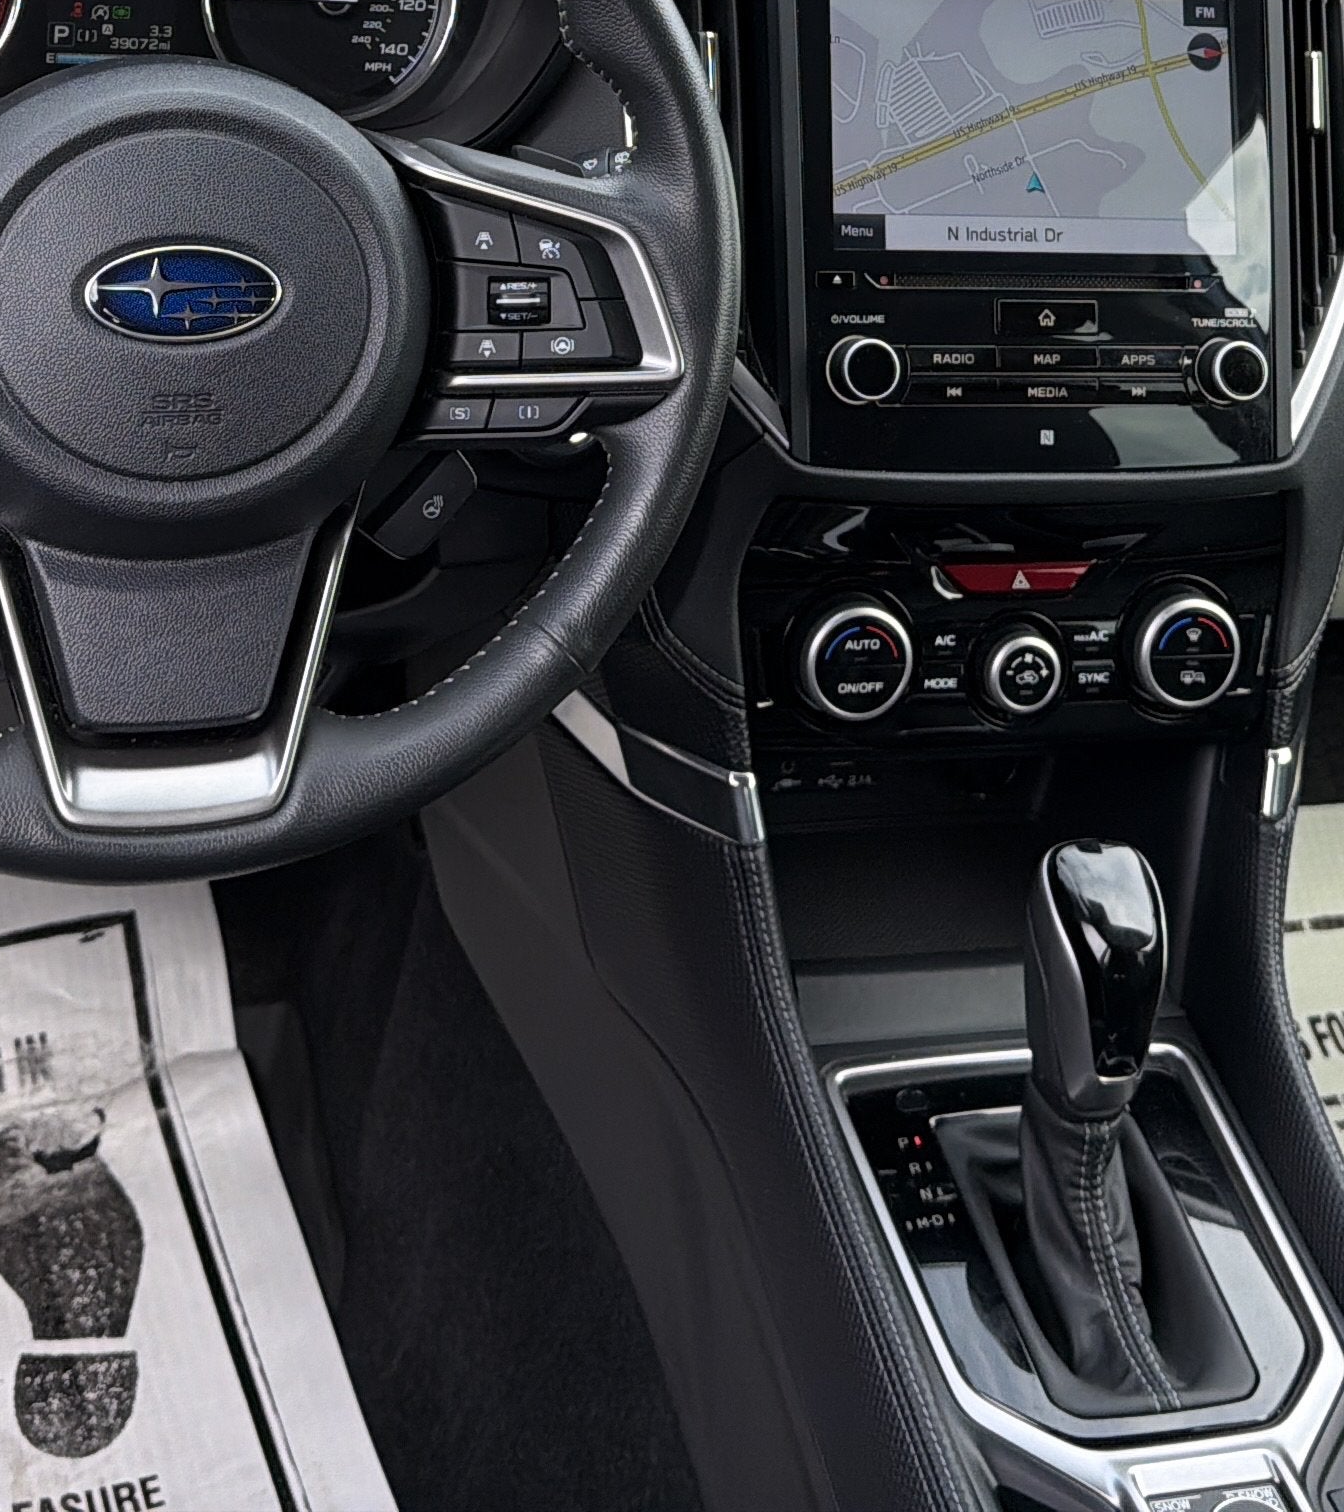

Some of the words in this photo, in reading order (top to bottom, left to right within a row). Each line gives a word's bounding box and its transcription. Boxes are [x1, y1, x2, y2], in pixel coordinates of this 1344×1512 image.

[369, 4, 389, 12] 200
[398, 0, 426, 11] 120
[1195, 6, 1215, 19] FM
[363, 21, 382, 29] 220
[53, 25, 70, 44] P
[149, 25, 173, 38] 3.3
[351, 35, 371, 44] 240
[379, 43, 409, 56] 140
[46, 53, 54, 64] E
[364, 62, 392, 73] MPH
[1074, 79, 1087, 91] US
[1126, 65, 1137, 77] 19
[952, 125, 965, 138] US
[1004, 105, 1015, 117] 19
[972, 162, 1015, 184] Northside
[1014, 155, 1026, 167] Dr
[834, 184, 847, 197] US
[847, 169, 888, 192] Highway
[887, 162, 898, 175] 19
[840, 225, 874, 237] Menu
[947, 226, 960, 241] N
[965, 226, 1038, 243] Industrial
[1044, 228, 1064, 243] Dr
[1191, 317, 1258, 328] TUNE/SCROLL
[933, 353, 975, 365] RADIO
[1033, 354, 1061, 365] MAP
[1121, 354, 1156, 365] APPS
[1027, 386, 1069, 398] MEDIA
[845, 638, 881, 650] AUTO
[935, 634, 957, 646] A/C
[924, 678, 958, 689] MODE
[1078, 672, 1110, 684] SYNC
[838, 681, 884, 694] ON/OFF
[898, 1136, 909, 1150] P
[908, 1161, 922, 1175] R
[919, 1185, 933, 1201] N
